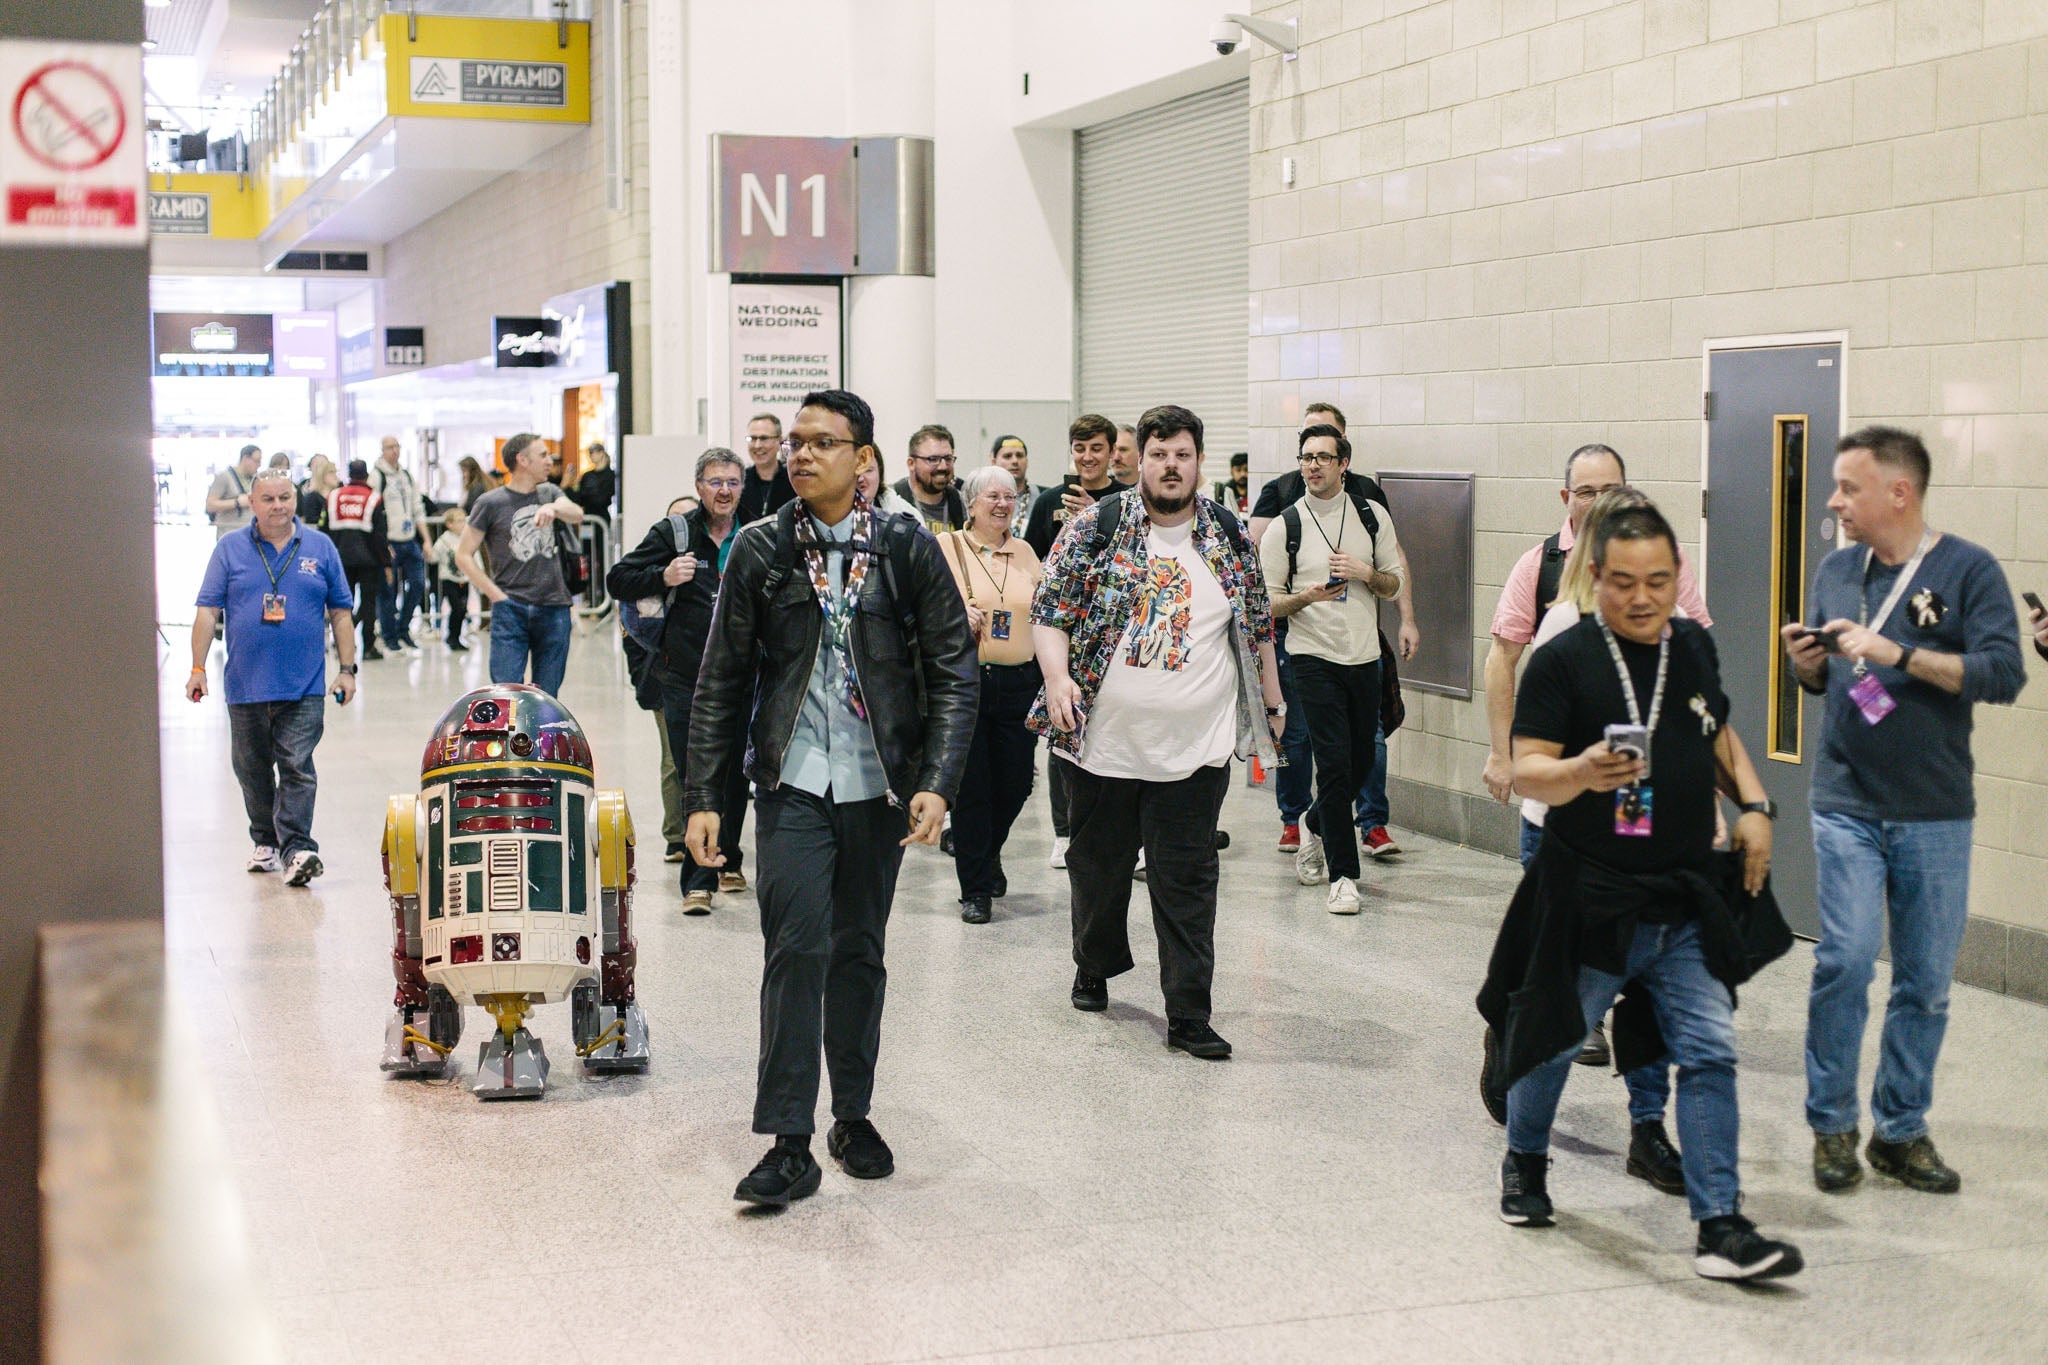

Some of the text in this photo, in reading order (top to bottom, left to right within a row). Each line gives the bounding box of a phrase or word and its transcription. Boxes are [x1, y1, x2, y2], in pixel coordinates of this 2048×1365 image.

[476, 64, 562, 89] PYRAMID
[741, 172, 825, 238] N1
[738, 305, 822, 315] NATIONAL
[738, 317, 818, 327] WEDDING
[743, 354, 828, 363] THE PERFECT
[743, 367, 828, 376] DESTINATION
[740, 381, 831, 390] FOR WEDDING
